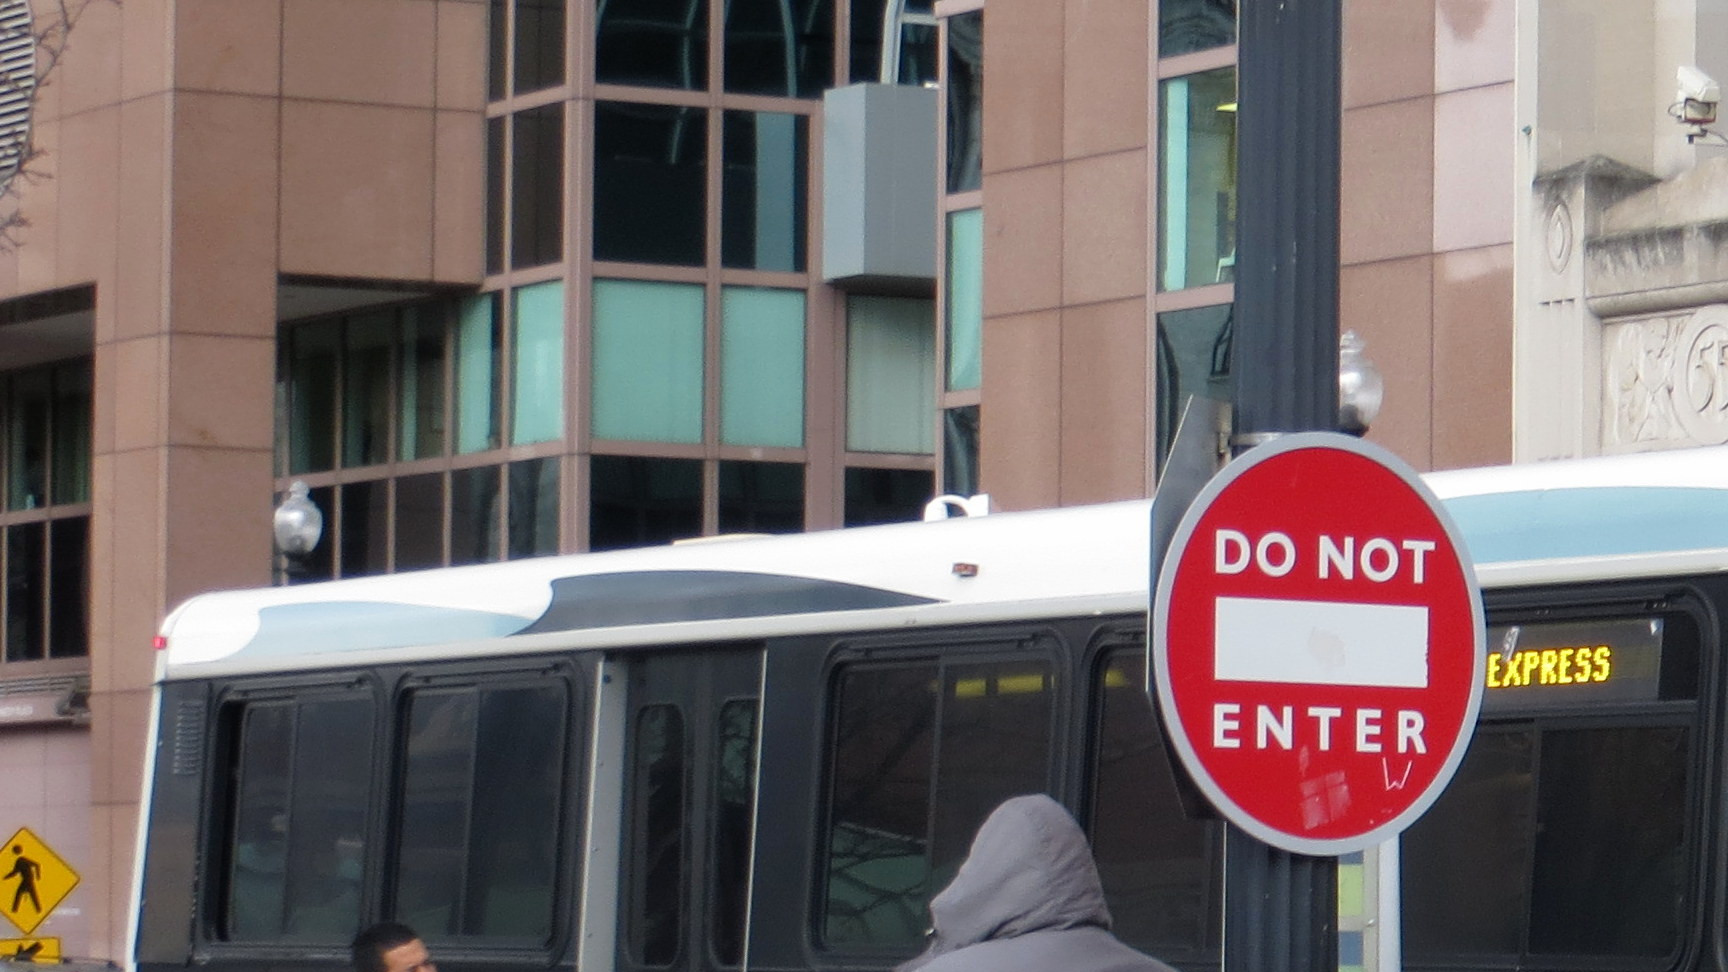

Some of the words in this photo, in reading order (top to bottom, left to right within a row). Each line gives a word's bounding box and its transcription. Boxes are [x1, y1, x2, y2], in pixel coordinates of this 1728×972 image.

[1215, 529, 1296, 577] DO
[1319, 535, 1436, 584] NOT
[1487, 645, 1612, 688] EXPRESS
[1213, 703, 1427, 754] ENTER
